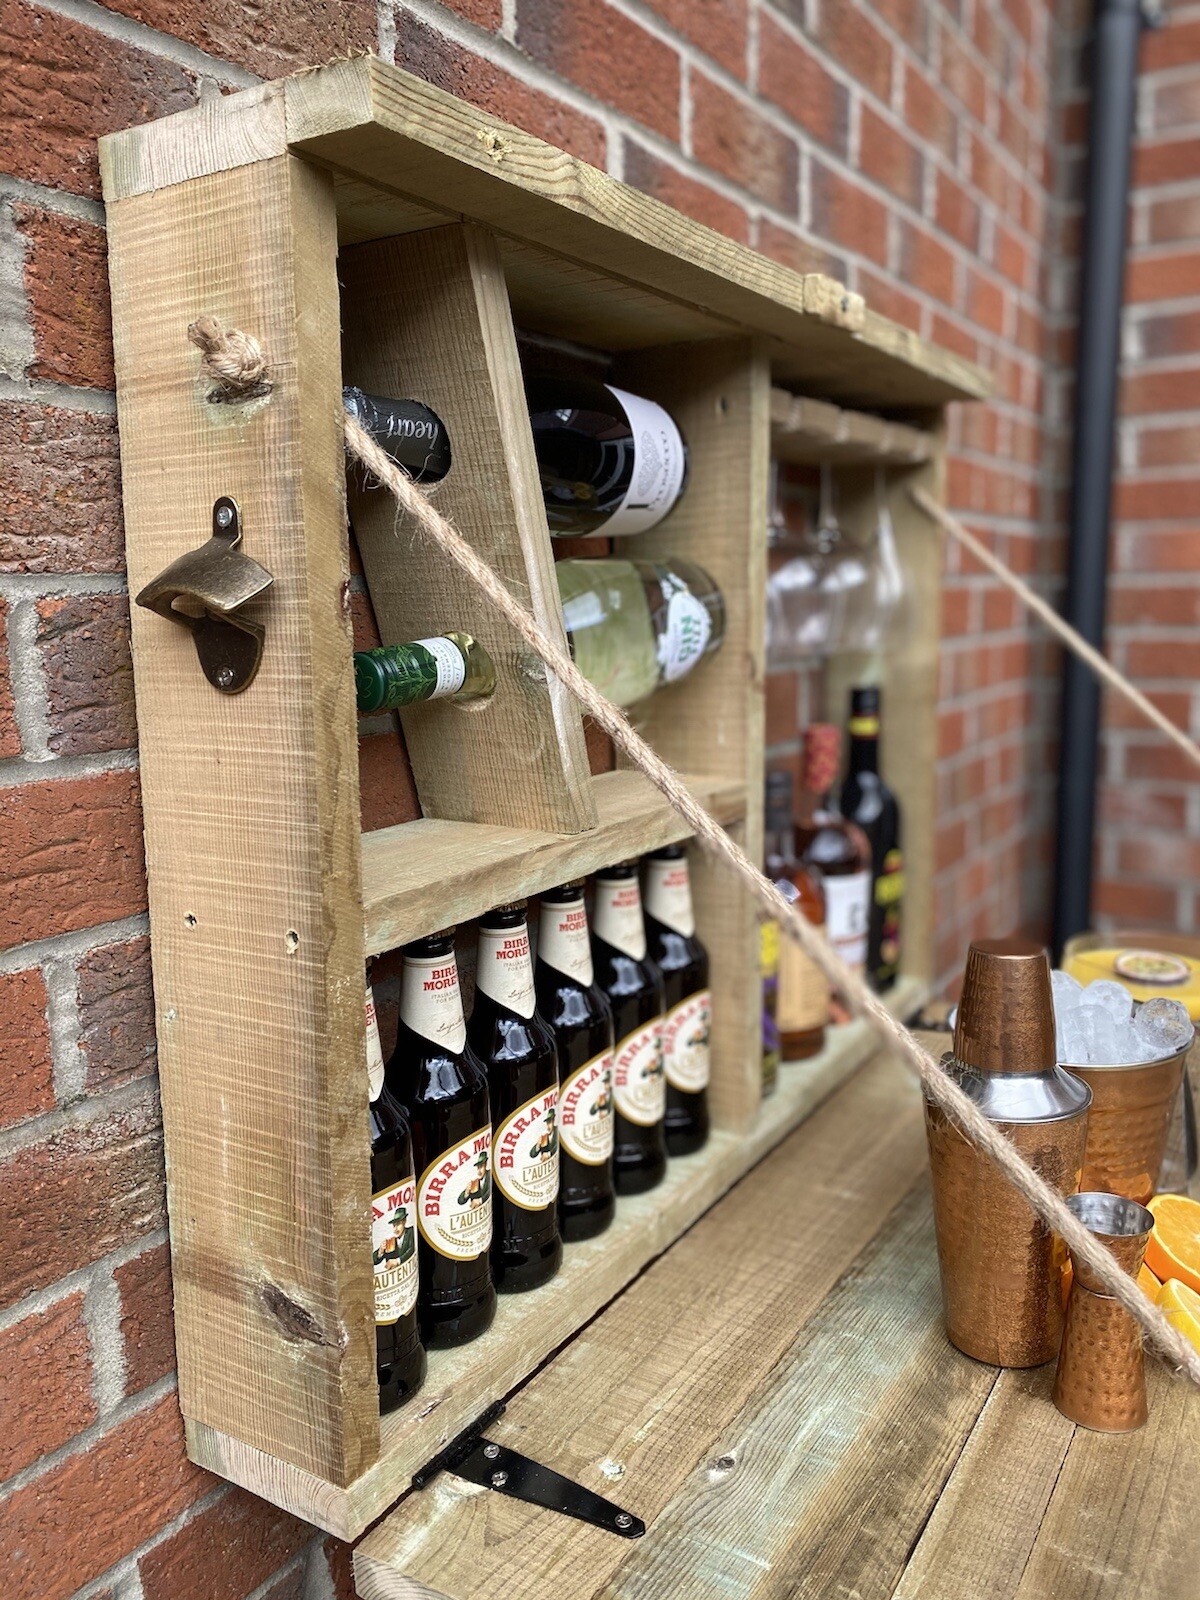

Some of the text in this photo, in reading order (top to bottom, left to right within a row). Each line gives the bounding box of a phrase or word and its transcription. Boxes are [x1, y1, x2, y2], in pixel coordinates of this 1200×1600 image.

[386, 413, 439, 450] heart
[563, 1068, 600, 1125] BIRRA
[500, 1106, 541, 1168] BIRRA
[425, 1150, 471, 1216] BIRRA
